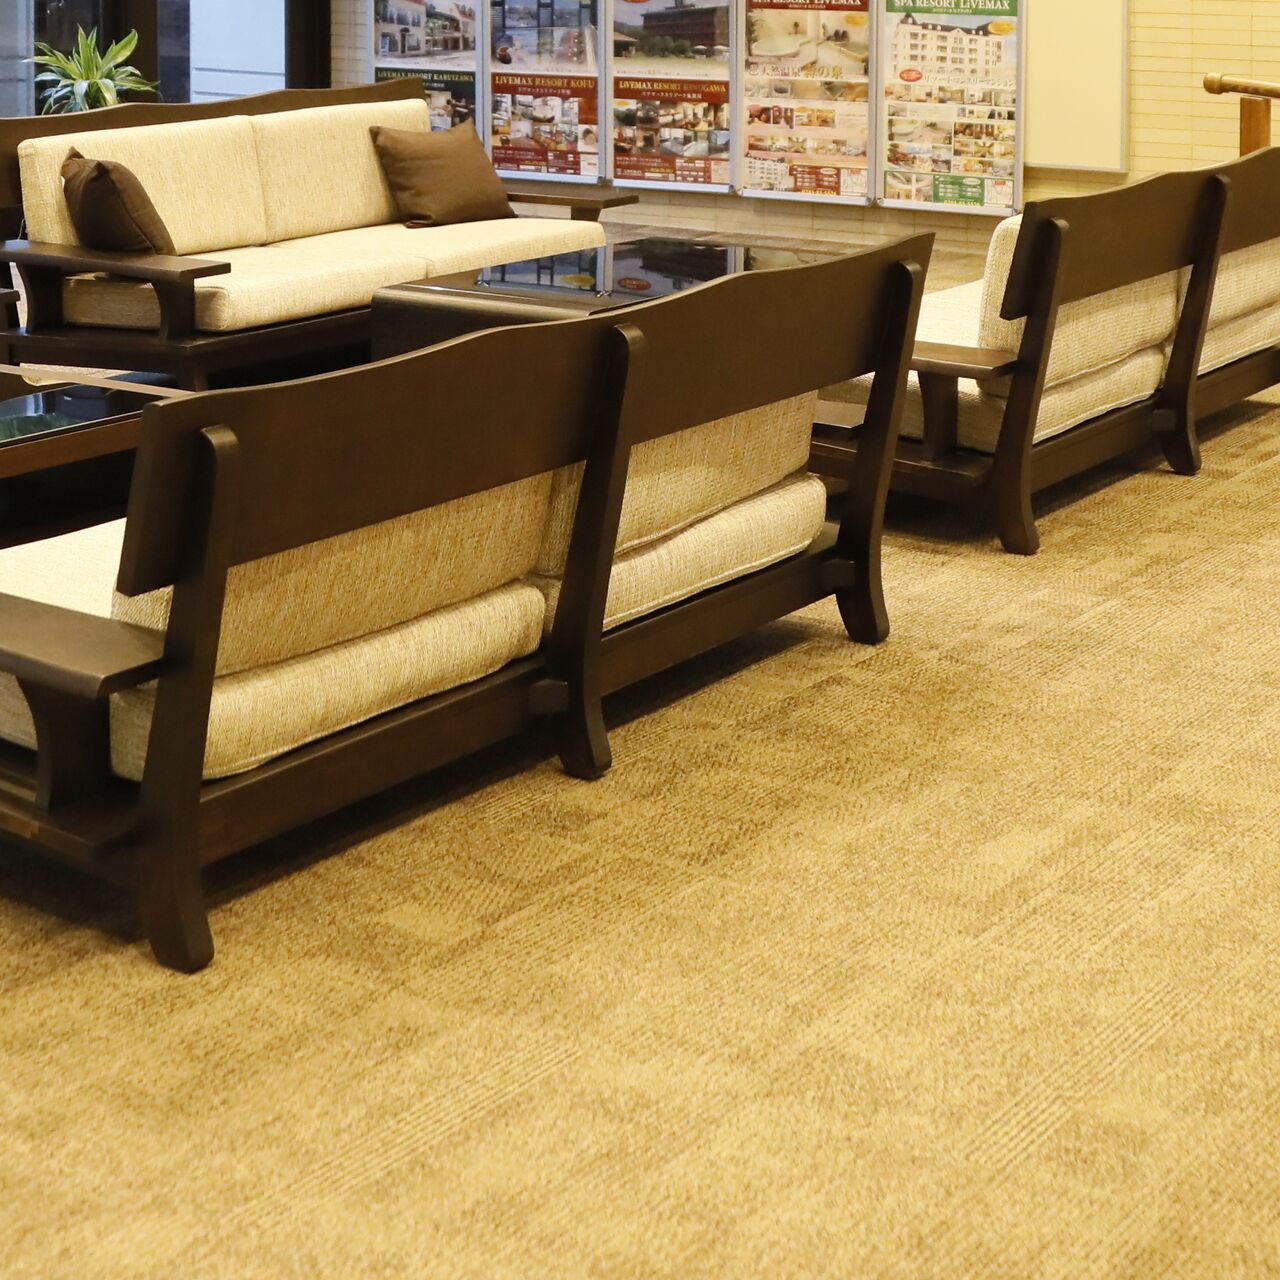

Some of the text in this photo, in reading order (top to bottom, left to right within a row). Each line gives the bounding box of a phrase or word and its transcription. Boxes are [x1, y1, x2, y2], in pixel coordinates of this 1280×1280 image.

[960, 0, 1010, 10] LiVEMAX
[434, 72, 473, 82] KARUIZAWA
[535, 78, 568, 87] RESORT
[570, 79, 595, 88] KOFU
[654, 81, 682, 91] RESORT
